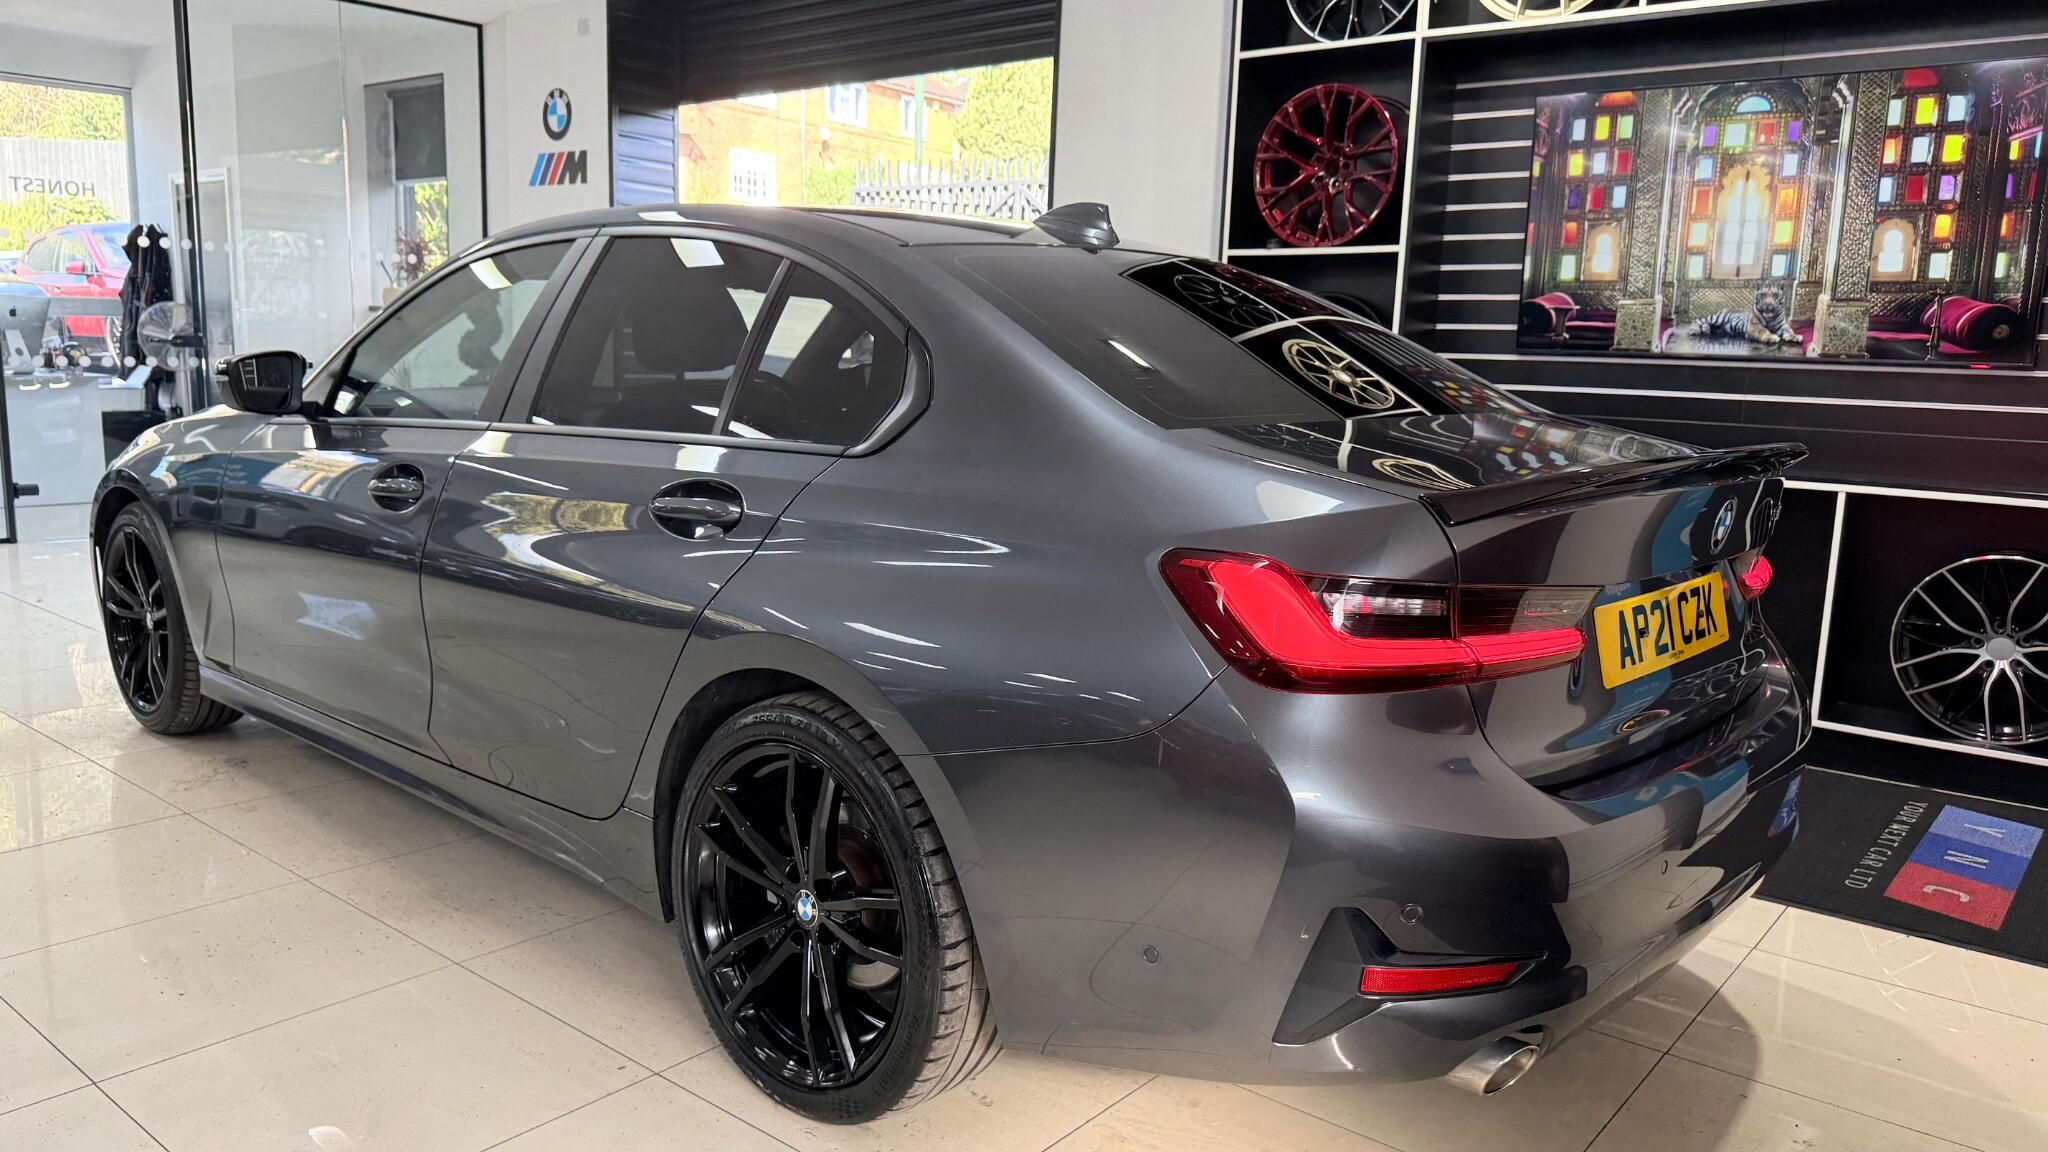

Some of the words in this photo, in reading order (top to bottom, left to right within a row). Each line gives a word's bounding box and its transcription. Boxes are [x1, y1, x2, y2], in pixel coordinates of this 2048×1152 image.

[556, 150, 588, 184] M
[1618, 596, 1676, 670] AP21
[1677, 582, 1718, 646] CZK
[1894, 801, 1929, 823] YOUR
[1877, 822, 1911, 847] NEXT
[1859, 847, 1892, 867] CAR
[1844, 868, 1877, 889] LTD
